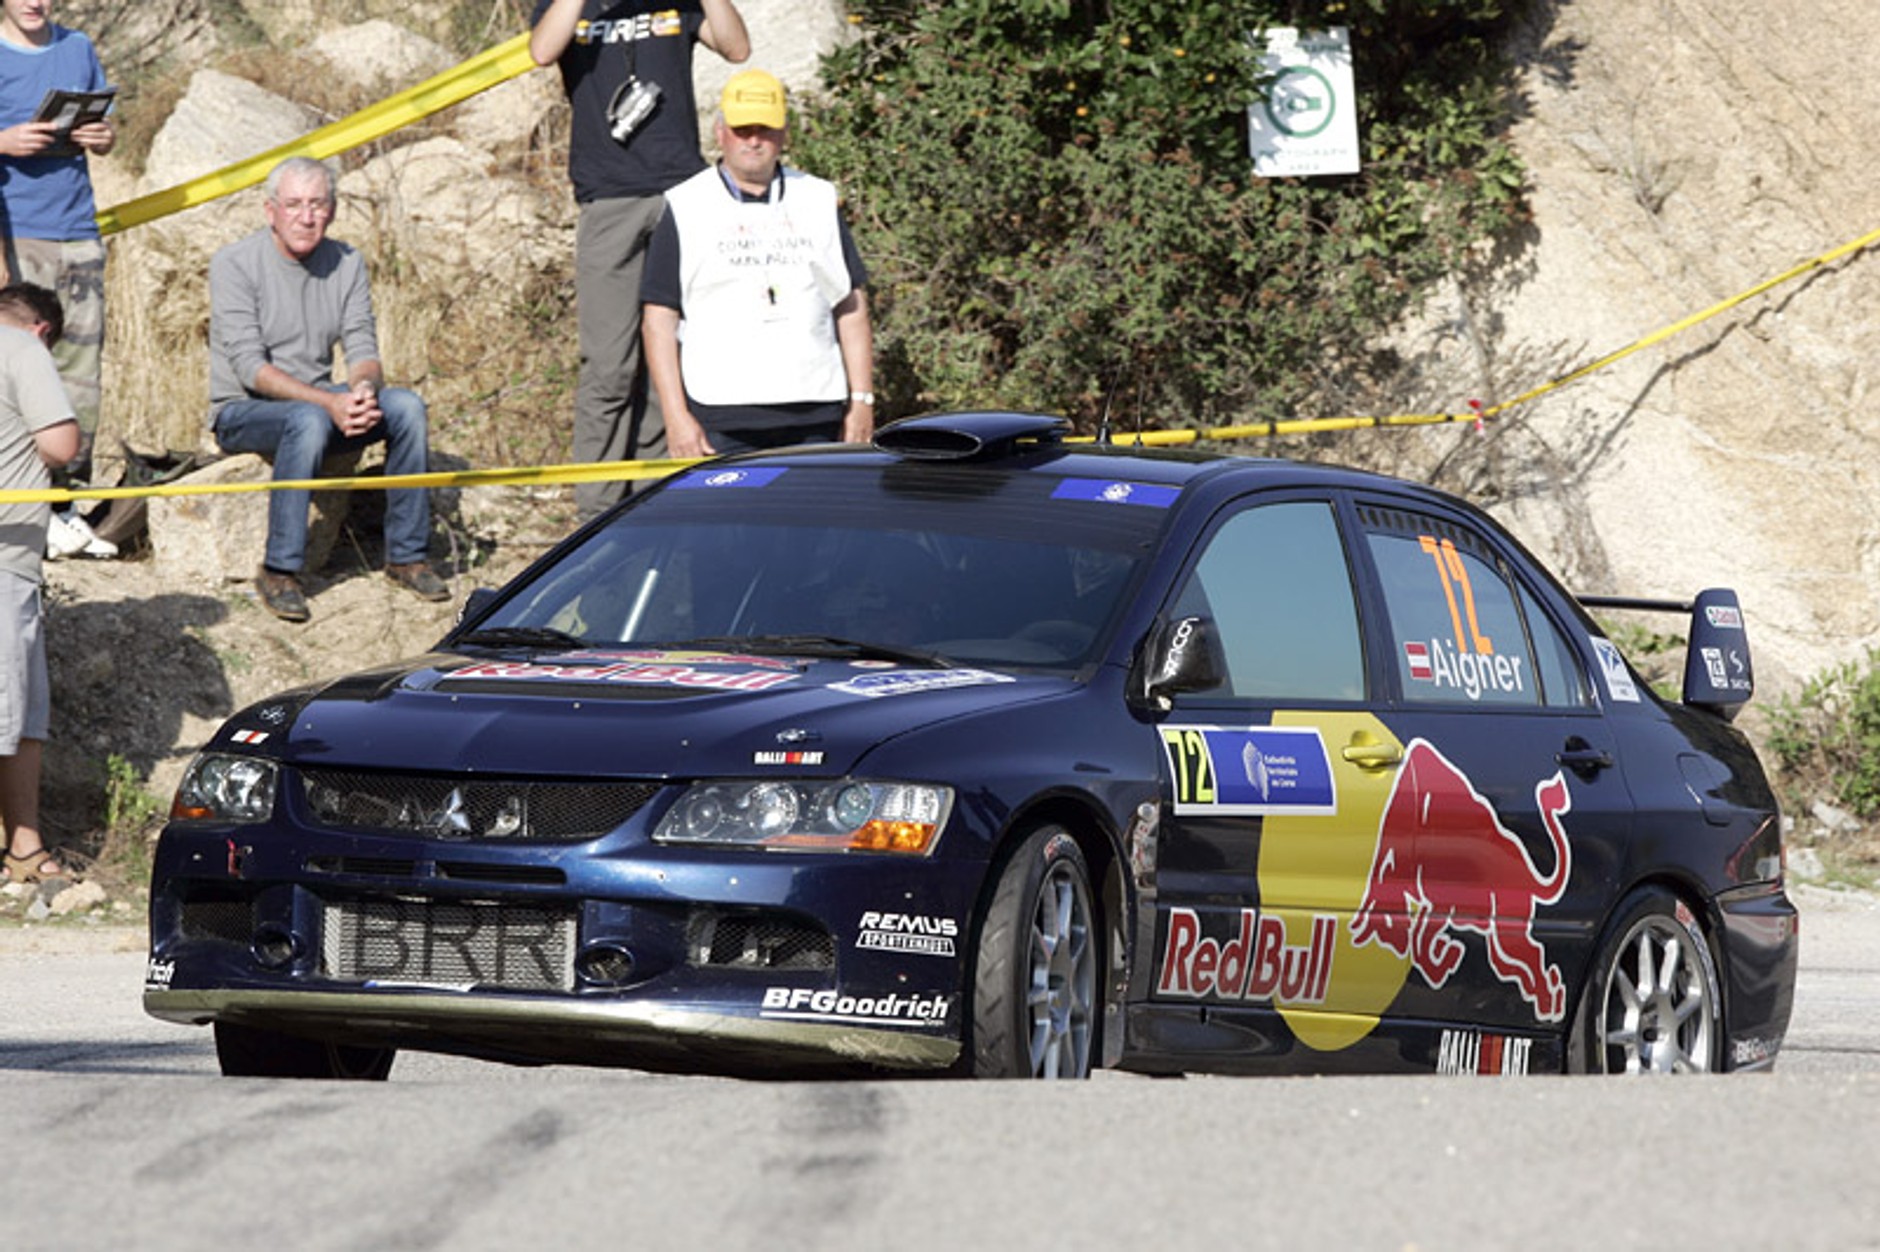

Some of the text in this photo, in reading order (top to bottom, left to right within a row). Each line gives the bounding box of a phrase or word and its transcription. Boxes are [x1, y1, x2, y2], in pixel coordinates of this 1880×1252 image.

[1418, 535, 1494, 656] 72
[1431, 638, 1523, 700] Aigner
[1163, 729, 1215, 803] 72
[354, 901, 558, 985] BRR
[859, 911, 959, 936] REMUS
[761, 987, 949, 1019] BFGoodrich
